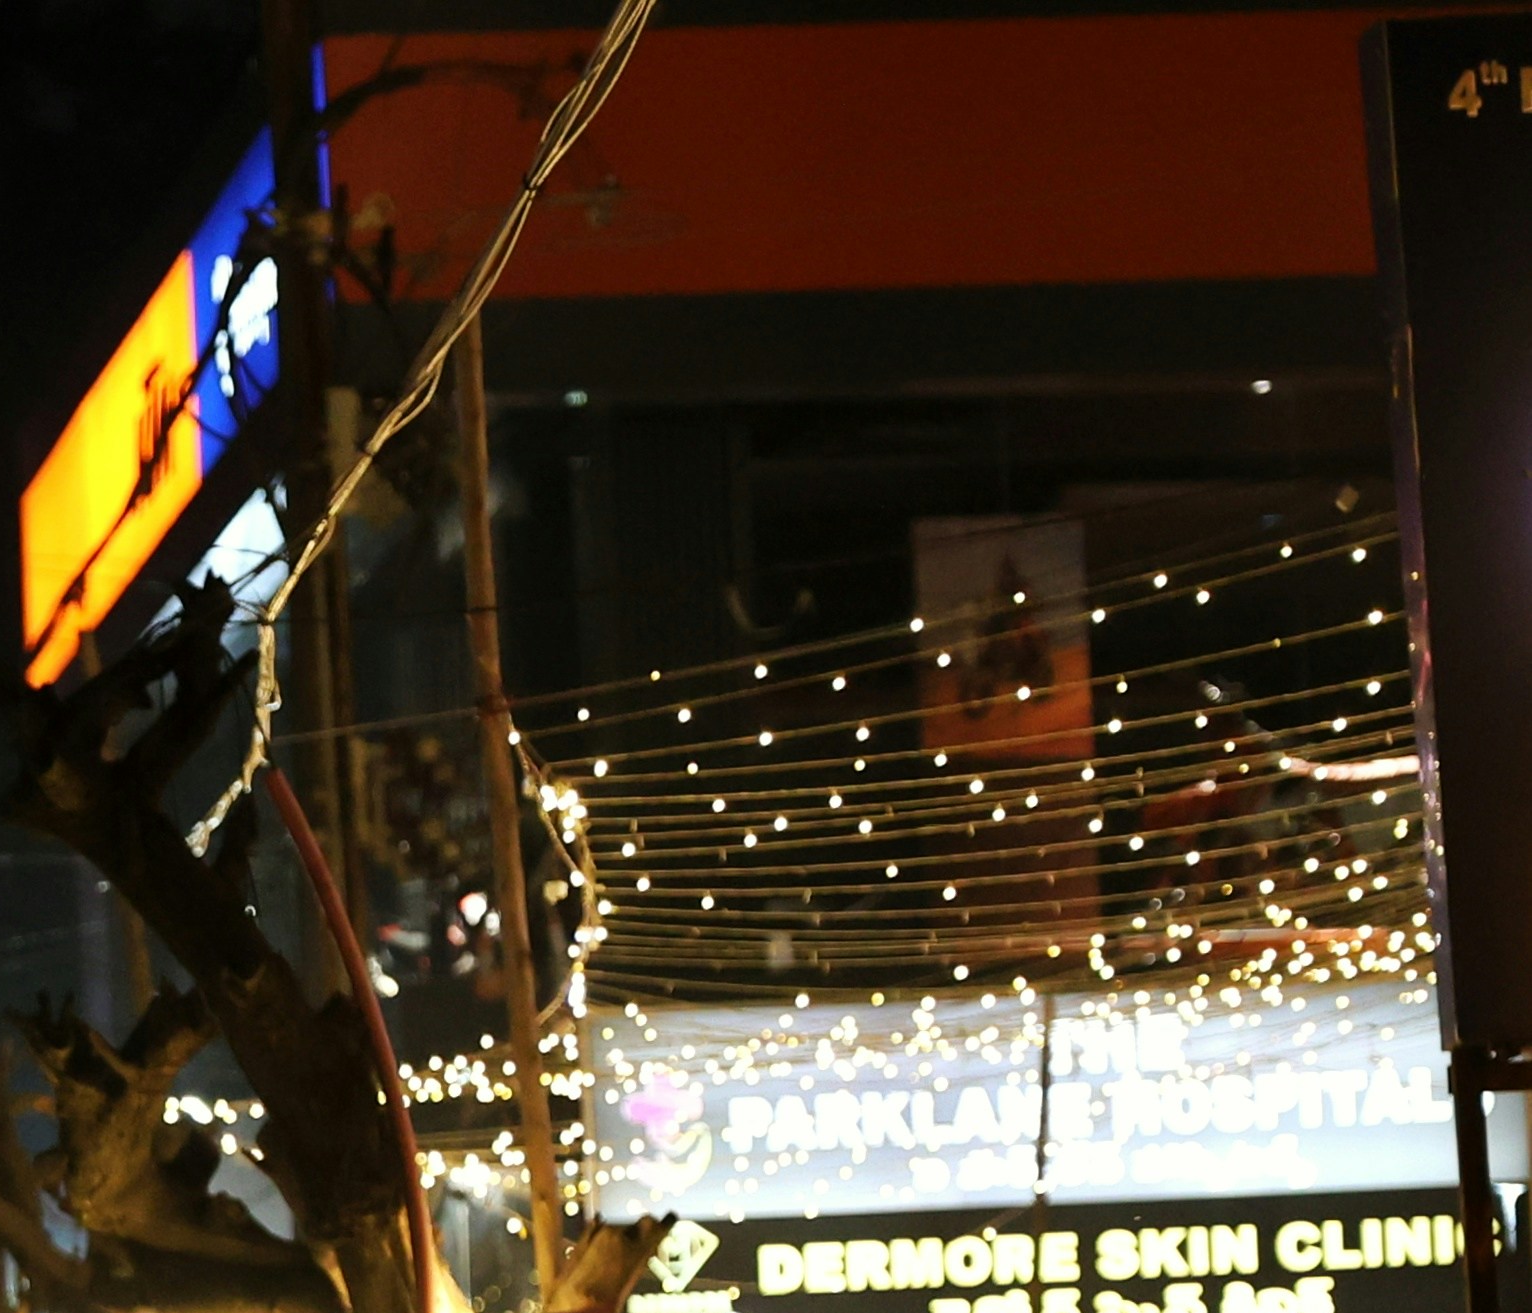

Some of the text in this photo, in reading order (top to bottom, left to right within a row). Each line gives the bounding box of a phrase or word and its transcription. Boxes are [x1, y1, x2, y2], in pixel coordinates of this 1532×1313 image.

[1448, 60, 1508, 118] 4th
[728, 1066, 1453, 1153] PARKLANE HOSPITAL
[758, 1232, 1080, 1295] DERMORE
[1095, 1223, 1260, 1281] SKIN
